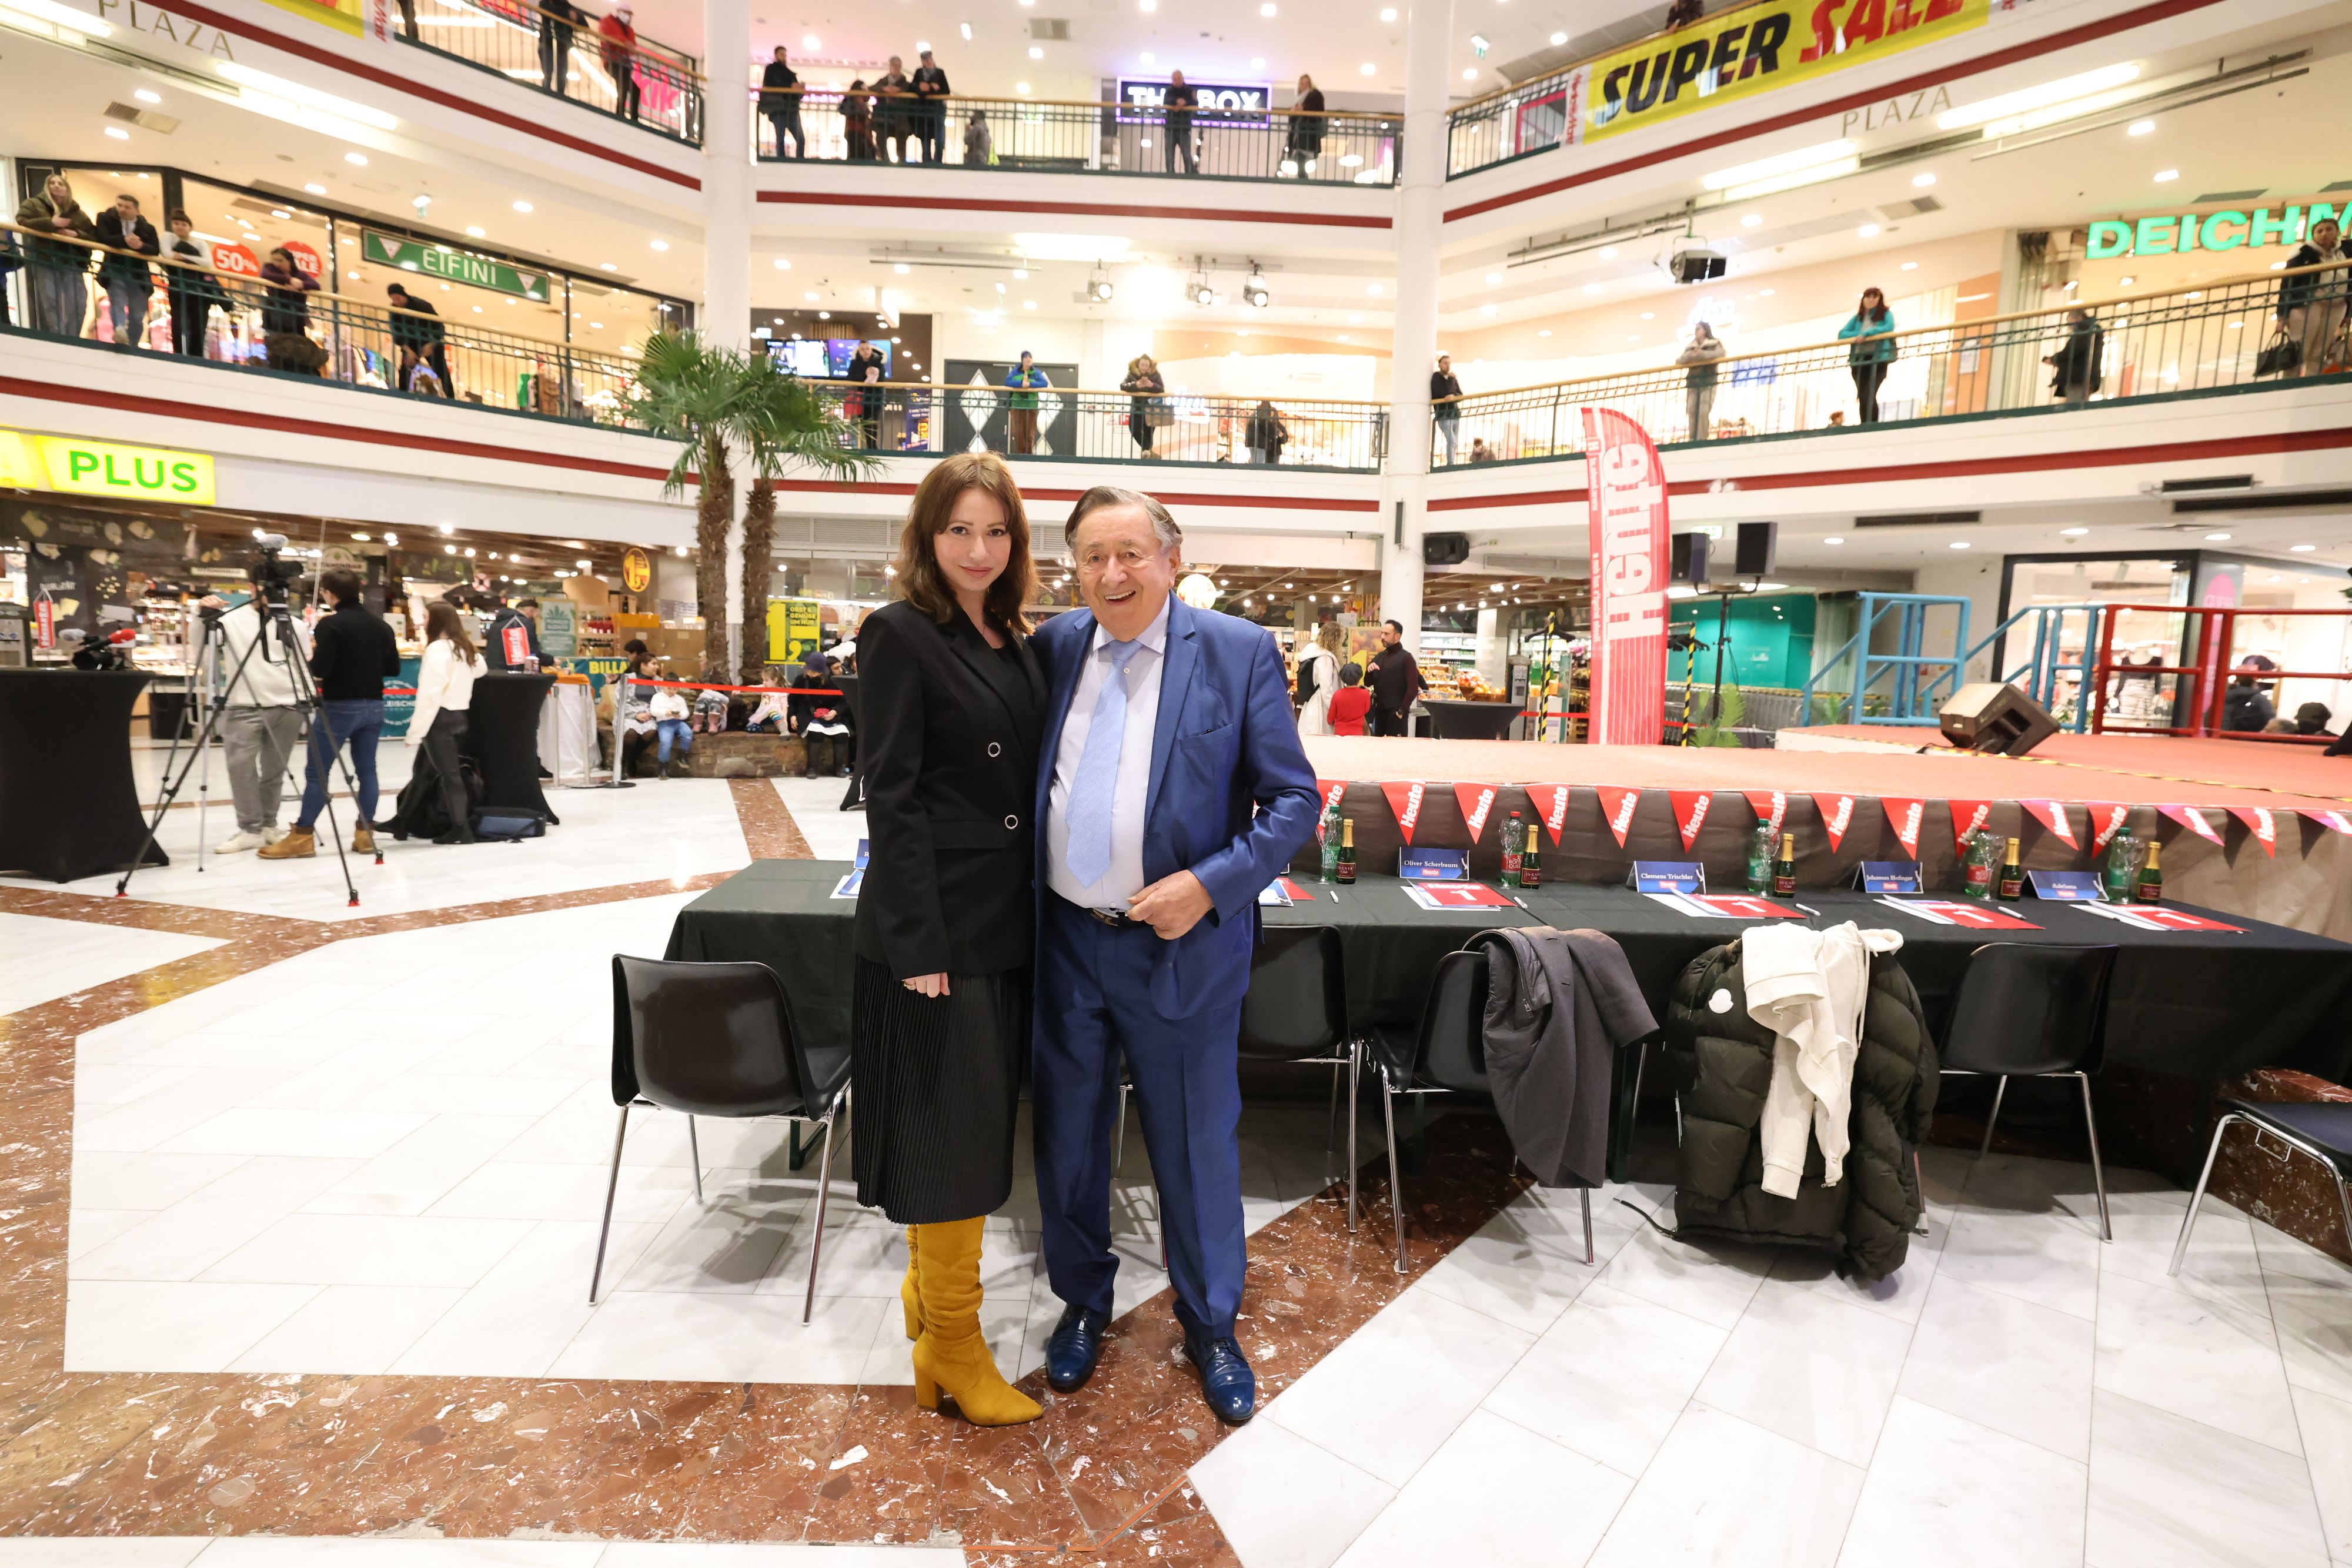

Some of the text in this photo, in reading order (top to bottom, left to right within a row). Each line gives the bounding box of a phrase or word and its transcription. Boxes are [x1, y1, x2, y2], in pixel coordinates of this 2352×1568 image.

[1602, 12, 1792, 123] SUPER
[1127, 86, 1260, 119] TH BOX
[1842, 86, 1952, 137] PLAZA
[423, 249, 496, 285] EIFINI
[69, 450, 197, 492] PLUS
[1400, 784, 1423, 828] Heute
[1468, 788, 1494, 830] Heute
[1548, 786, 1568, 830] Heute
[1612, 792, 1637, 834] Heute
[1682, 794, 1709, 838] Heute
[1828, 796, 1853, 837] Heute
[1900, 802, 1922, 845] Heute
[2095, 806, 2127, 847] Heute
